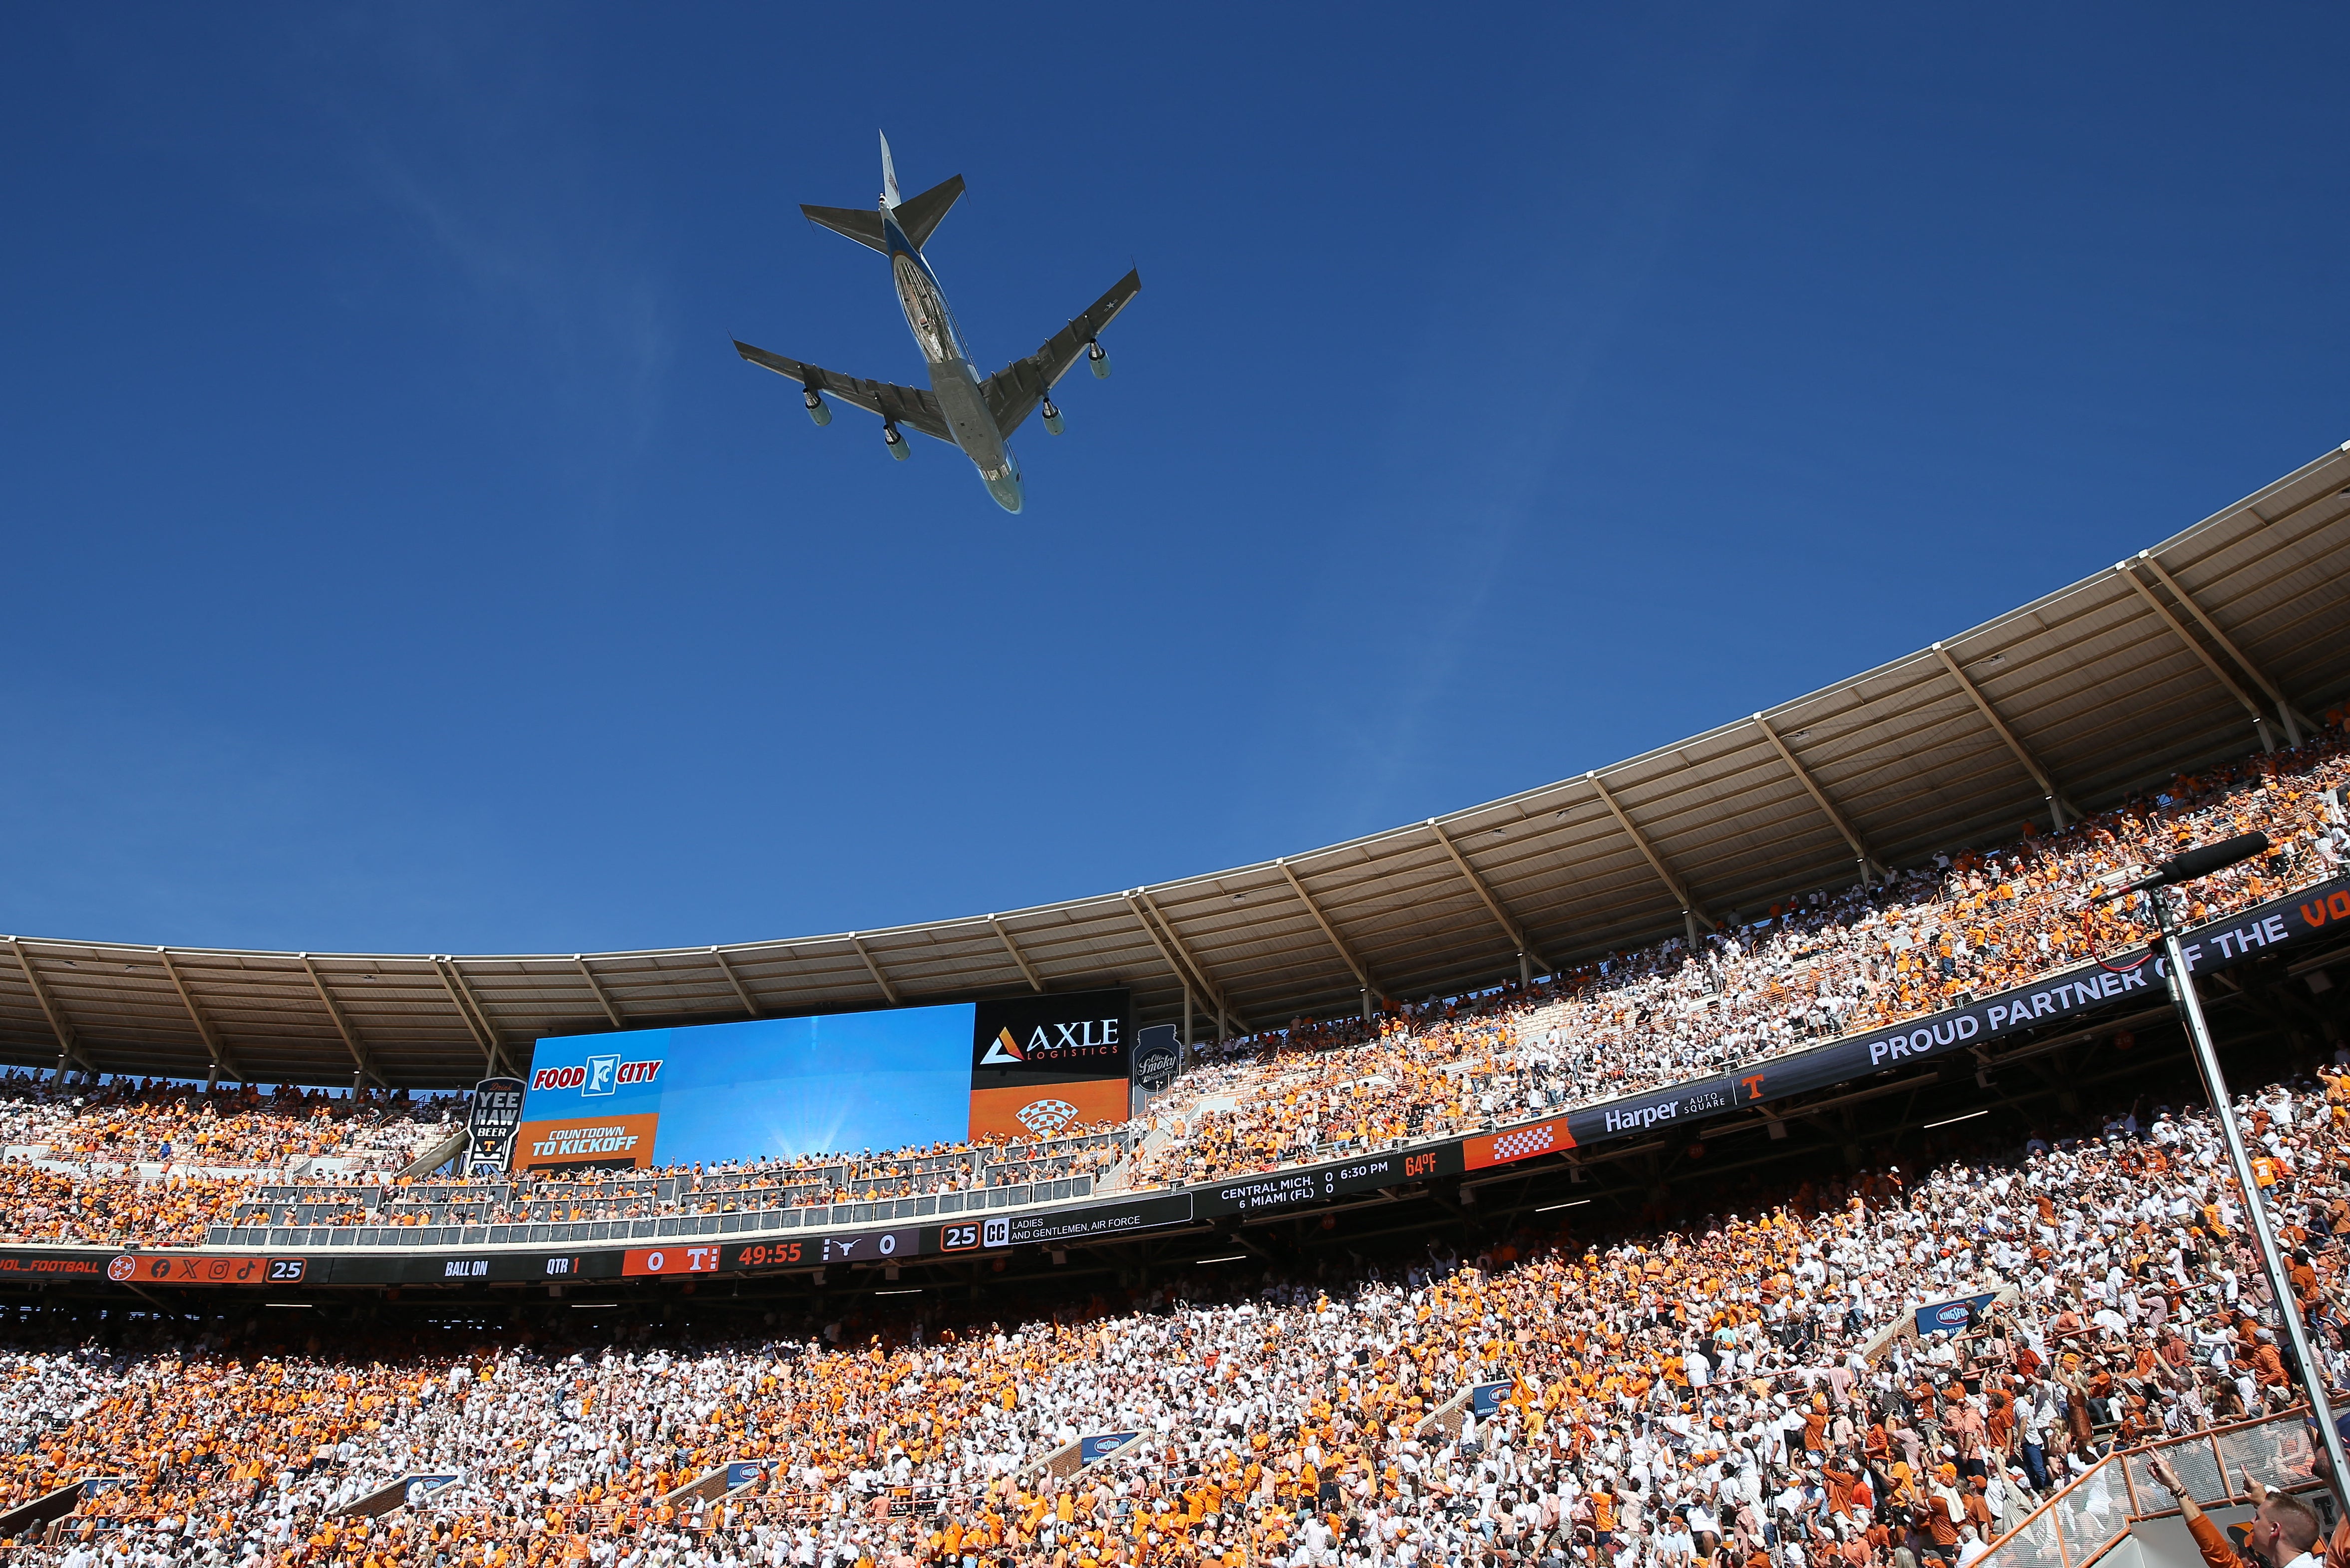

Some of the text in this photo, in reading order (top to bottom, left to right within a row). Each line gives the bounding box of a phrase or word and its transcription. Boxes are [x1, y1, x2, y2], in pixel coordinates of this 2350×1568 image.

[1869, 1015, 1979, 1065] PROUD
[1988, 966, 2148, 1030] PARTNER
[2210, 913, 2290, 959] THE
[1026, 1018, 1119, 1052] AXLE
[1027, 1045, 1118, 1060] LOGISTICS
[1151, 1054, 1165, 1063] Ole
[1137, 1055, 1177, 1076] Smoky
[532, 1066, 586, 1091] FOOD
[617, 1059, 664, 1083] CITY
[489, 1082, 513, 1091] Drink
[1742, 1074, 1764, 1100] T
[479, 1092, 520, 1108] YEE
[1684, 1100, 1725, 1115] SQUARE
[475, 1109, 518, 1126] HAW
[1605, 1092, 1718, 1132] Harper AUTO
[477, 1128, 507, 1137] BEER
[549, 1126, 626, 1140] COUNTDOWN
[484, 1140, 496, 1152] T
[532, 1135, 639, 1156] TO KICKOFF
[1221, 1161, 1388, 1200] CENTRAL MICH. 0 6:30 PM
[1239, 1183, 1334, 1209] 6 MIAMI (FL) 0
[1011, 1216, 1140, 1240] AND GENTLEMEN, AIR FORCE
[1012, 1218, 1043, 1230] LADIES
[879, 1235, 896, 1254] 0
[946, 1226, 976, 1247] 25
[648, 1248, 708, 1271] 0 T
[738, 1243, 802, 1265] 49:55
[272, 1262, 302, 1278] 25
[445, 1260, 488, 1276] BALL ON
[546, 1257, 579, 1275] QTR 1
[1939, 1306, 1970, 1320] KINGSFOR
[1097, 1440, 1120, 1451] KINGSFORD
[742, 1467, 759, 1477] KINGSFO
[661, 1508, 666, 1517] 5
